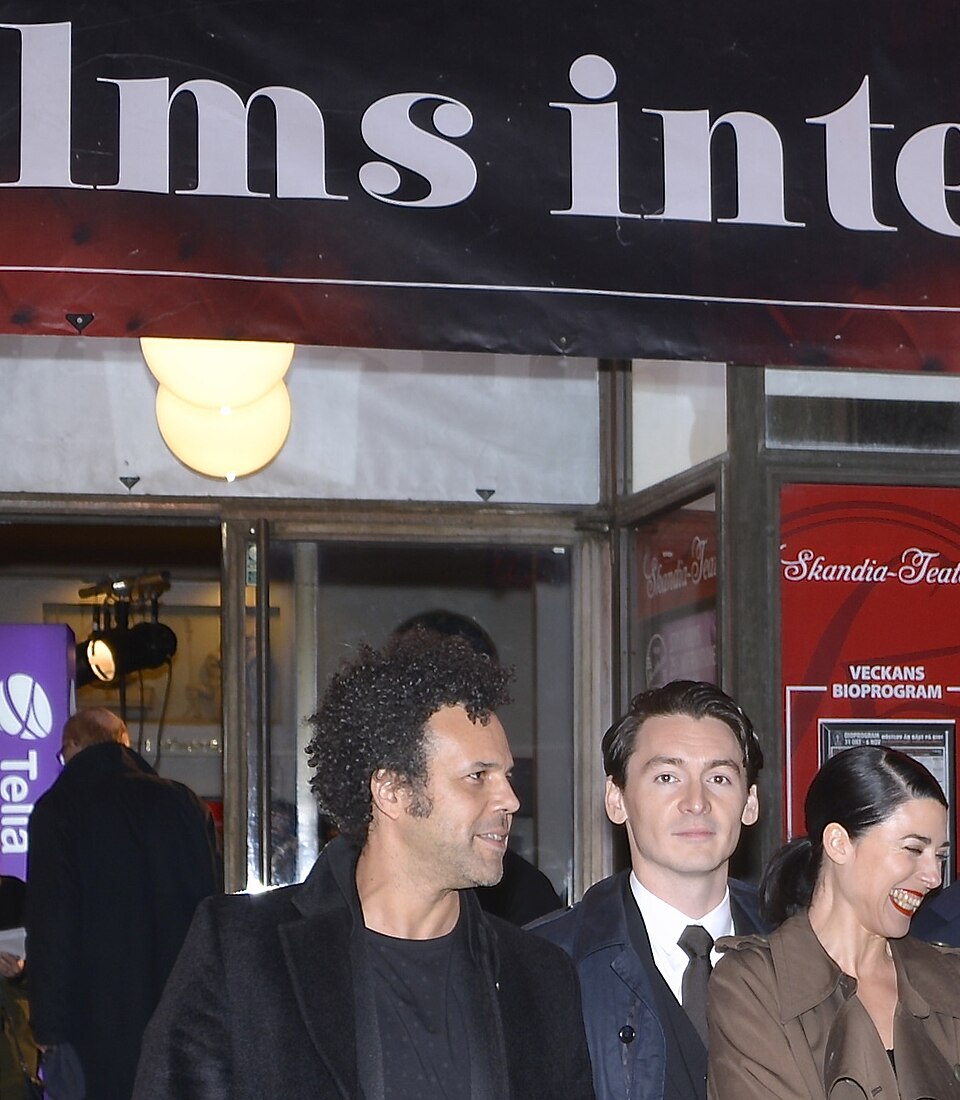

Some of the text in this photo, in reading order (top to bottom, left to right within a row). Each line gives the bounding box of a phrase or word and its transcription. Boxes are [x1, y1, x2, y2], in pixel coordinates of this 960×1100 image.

[0, 20, 477, 209] lms
[849, 665, 925, 681] VECKANS
[832, 683, 942, 699] BIOPROGRAM
